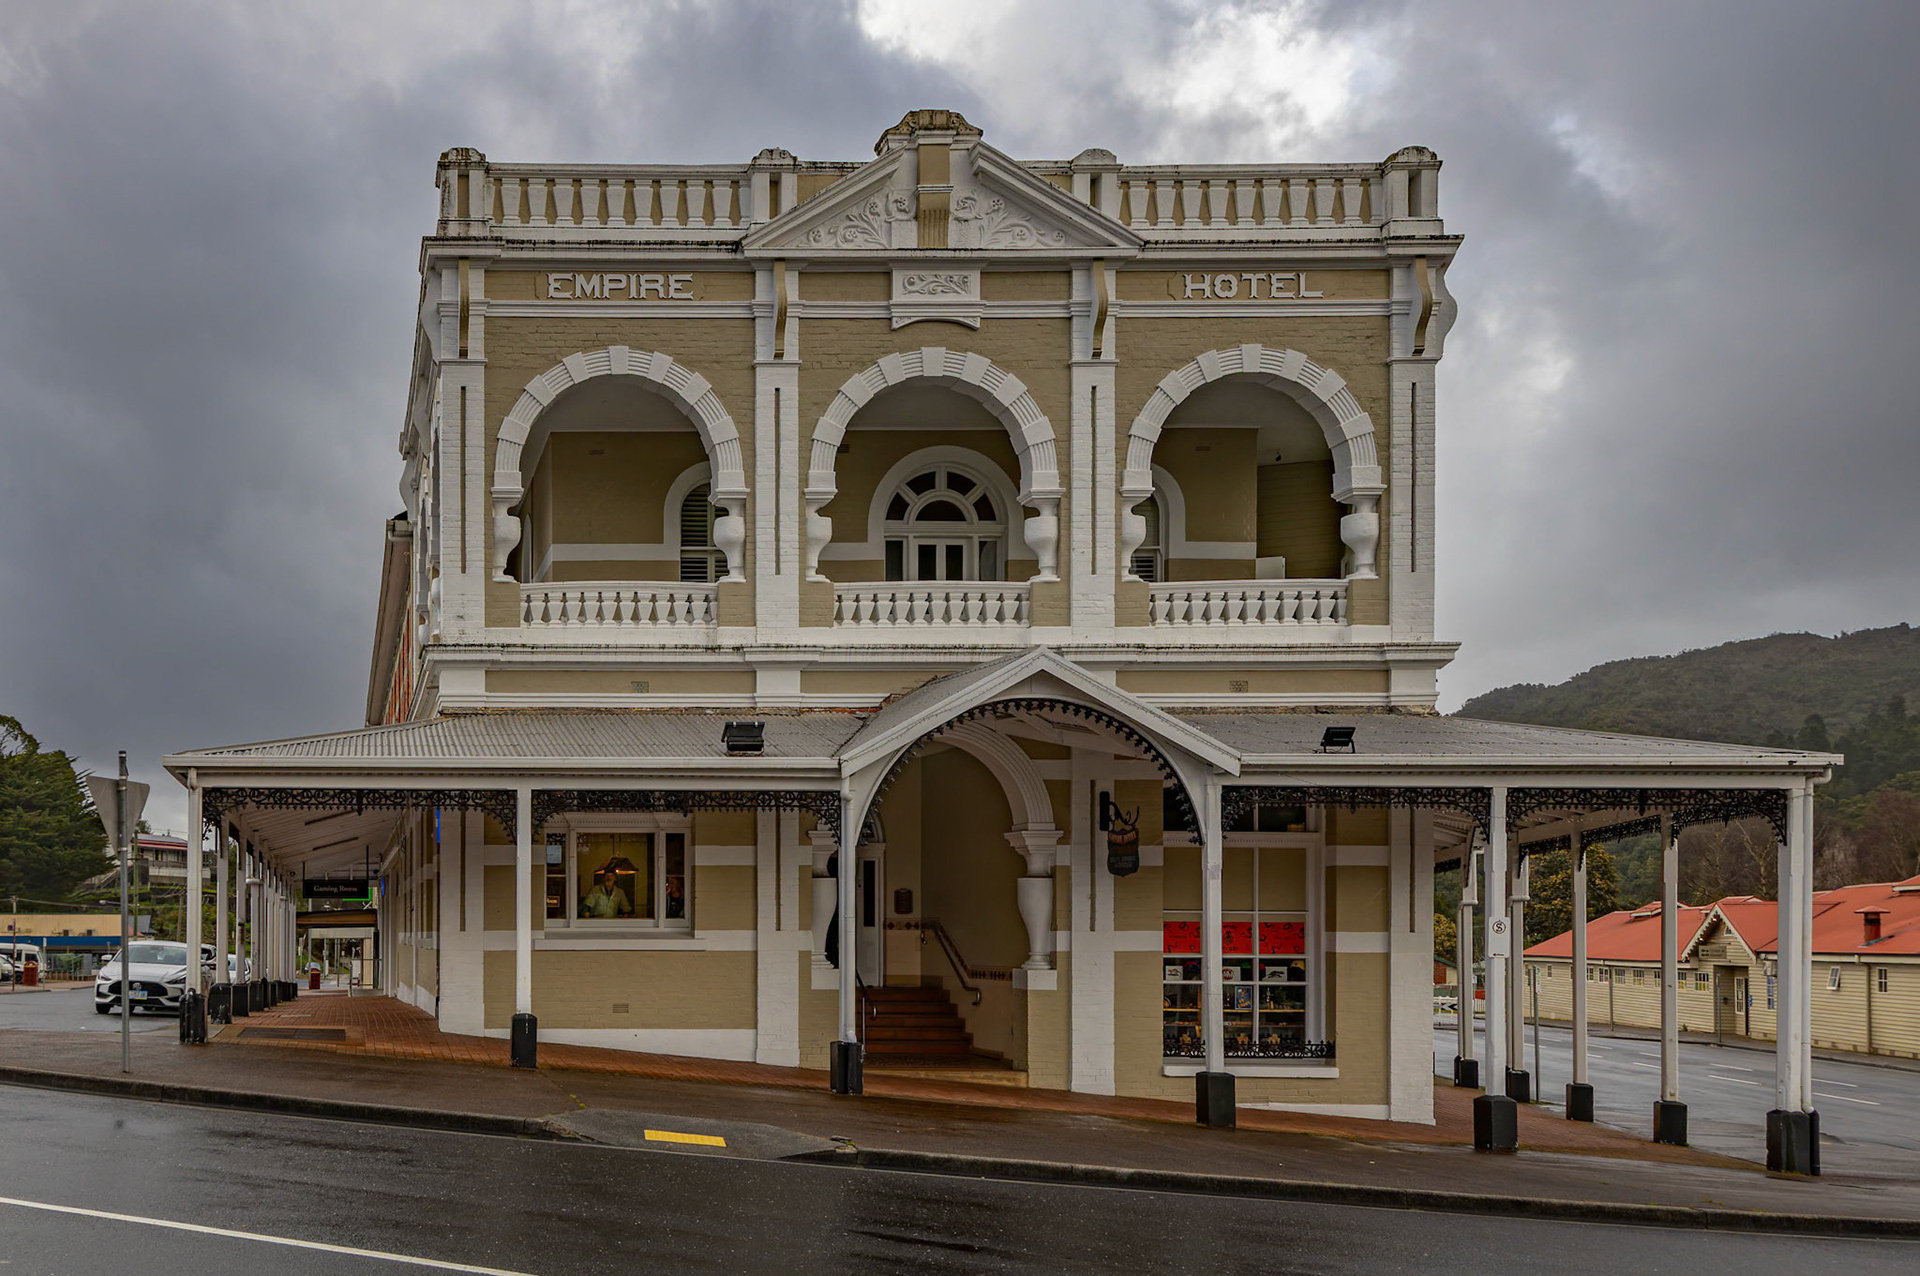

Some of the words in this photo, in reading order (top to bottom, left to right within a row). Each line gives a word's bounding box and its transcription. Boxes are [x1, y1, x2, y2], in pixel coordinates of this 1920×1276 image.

[546, 273, 694, 300] EMPIRE
[1183, 272, 1324, 299] HOTEL
[313, 885, 339, 893] Gaming
